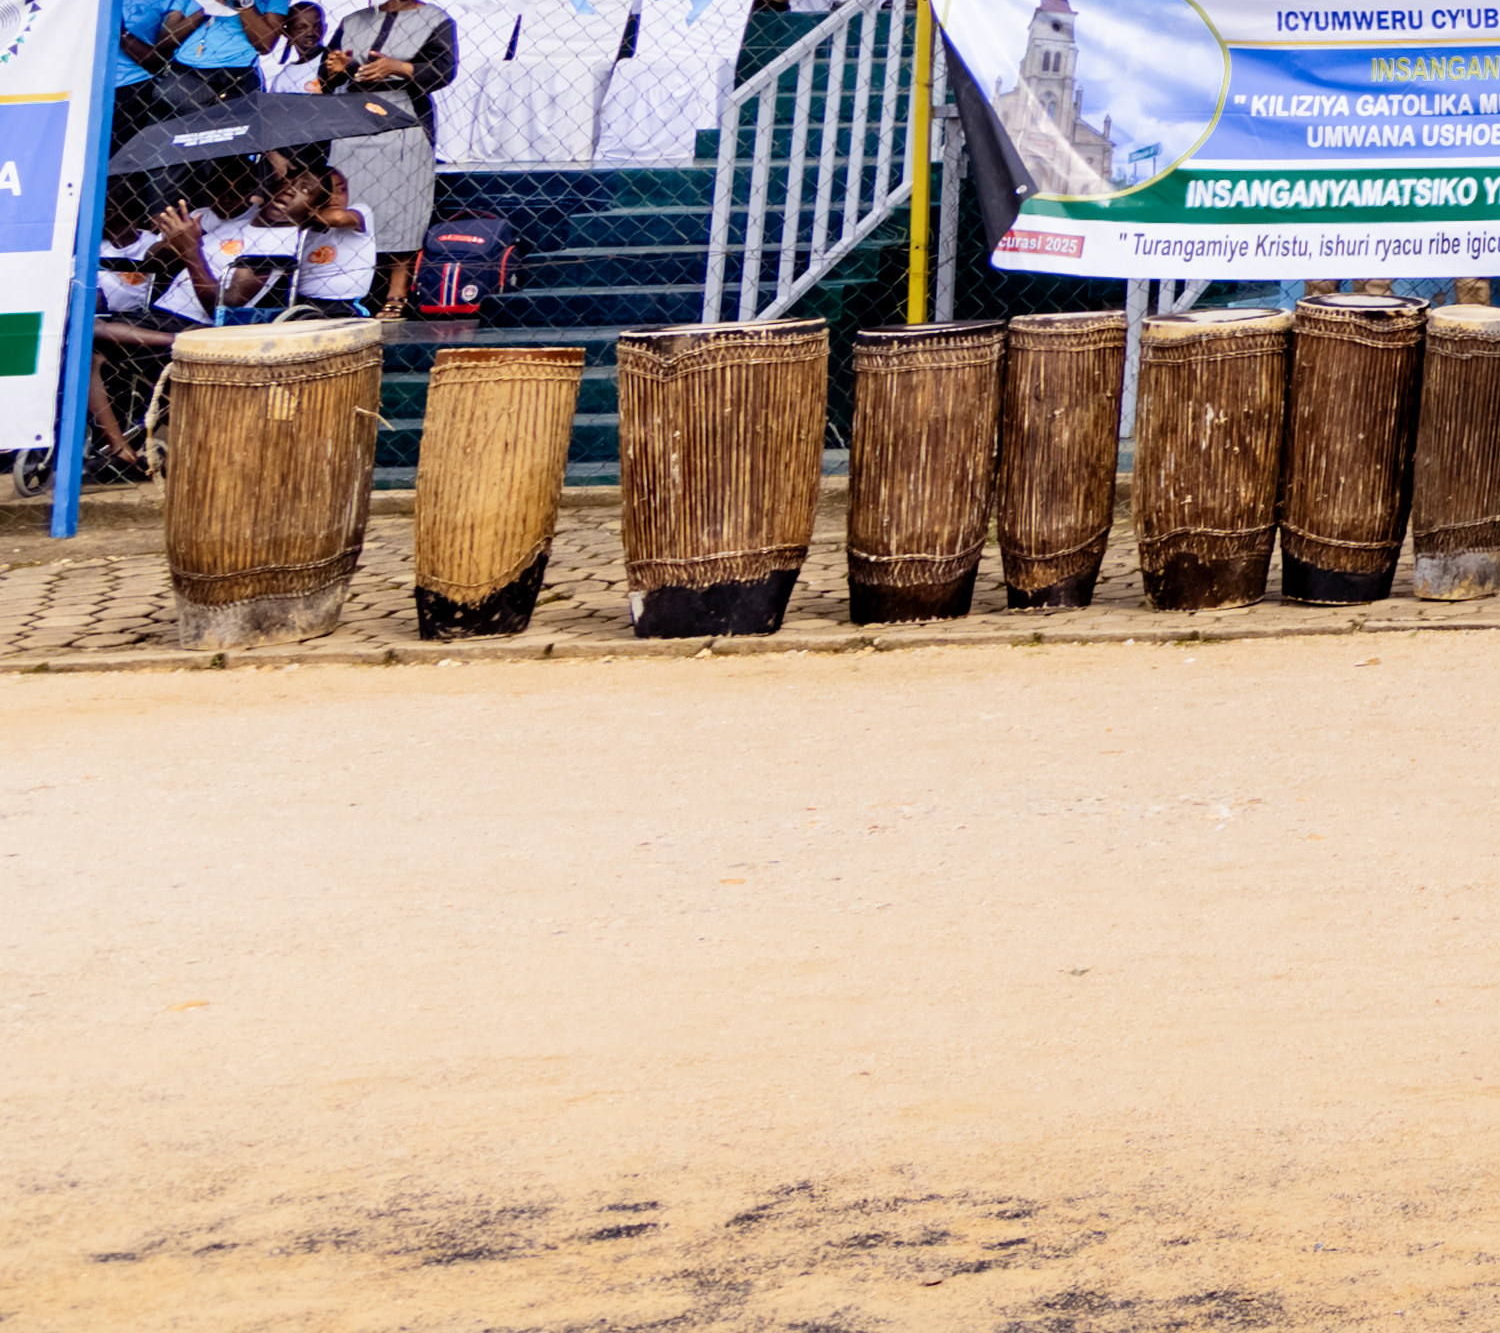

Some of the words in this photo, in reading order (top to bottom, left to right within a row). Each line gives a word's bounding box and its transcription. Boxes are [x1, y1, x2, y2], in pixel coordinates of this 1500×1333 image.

[1276, 10, 1423, 32] ICYUMWERU
[1251, 94, 1350, 117] KILIZIYA
[1356, 93, 1475, 117] GATOLIKA
[1307, 125, 1416, 148] UMWANA
[1185, 176, 1478, 209] INSANGANYAMATSIKO
[1045, 235, 1079, 254] 2025
[1133, 233, 1249, 262] Turangamiye
[1255, 234, 1313, 261] Kristu,
[1319, 232, 1370, 257] ishuri
[1375, 236, 1422, 264] ryacu
[1427, 232, 1461, 256] ribe
